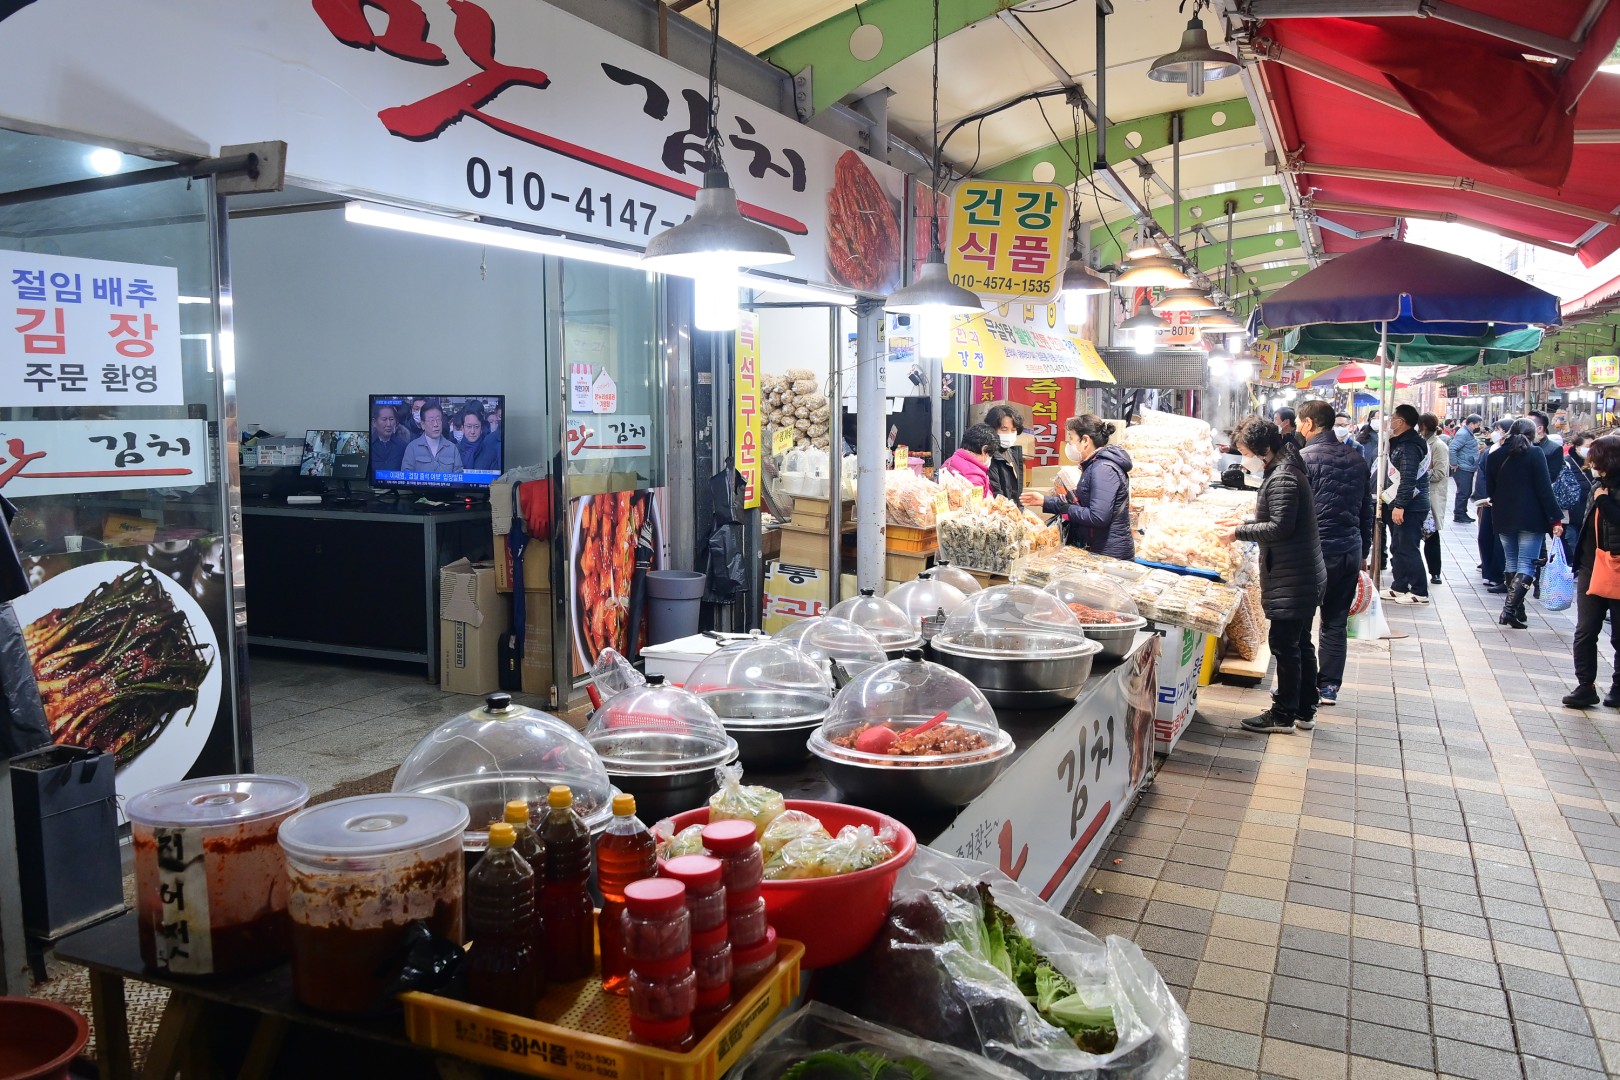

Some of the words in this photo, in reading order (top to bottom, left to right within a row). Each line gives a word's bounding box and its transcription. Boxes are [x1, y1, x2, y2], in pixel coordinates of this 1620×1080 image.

[601, 62, 807, 192] 김치
[466, 156, 690, 237] 010-4147-
[963, 188, 1058, 230] 건강
[957, 232, 1051, 274] 식품
[11, 269, 82, 304] 절임
[92, 277, 158, 308] 배추
[952, 273, 1051, 293] 010-4574-1535
[24, 363, 88, 393] 주문
[101, 363, 158, 393] 환영
[958, 351, 984, 369] 강정
[89, 431, 190, 468] 김치
[608, 421, 646, 444] 김치
[1057, 715, 1114, 841] 김치
